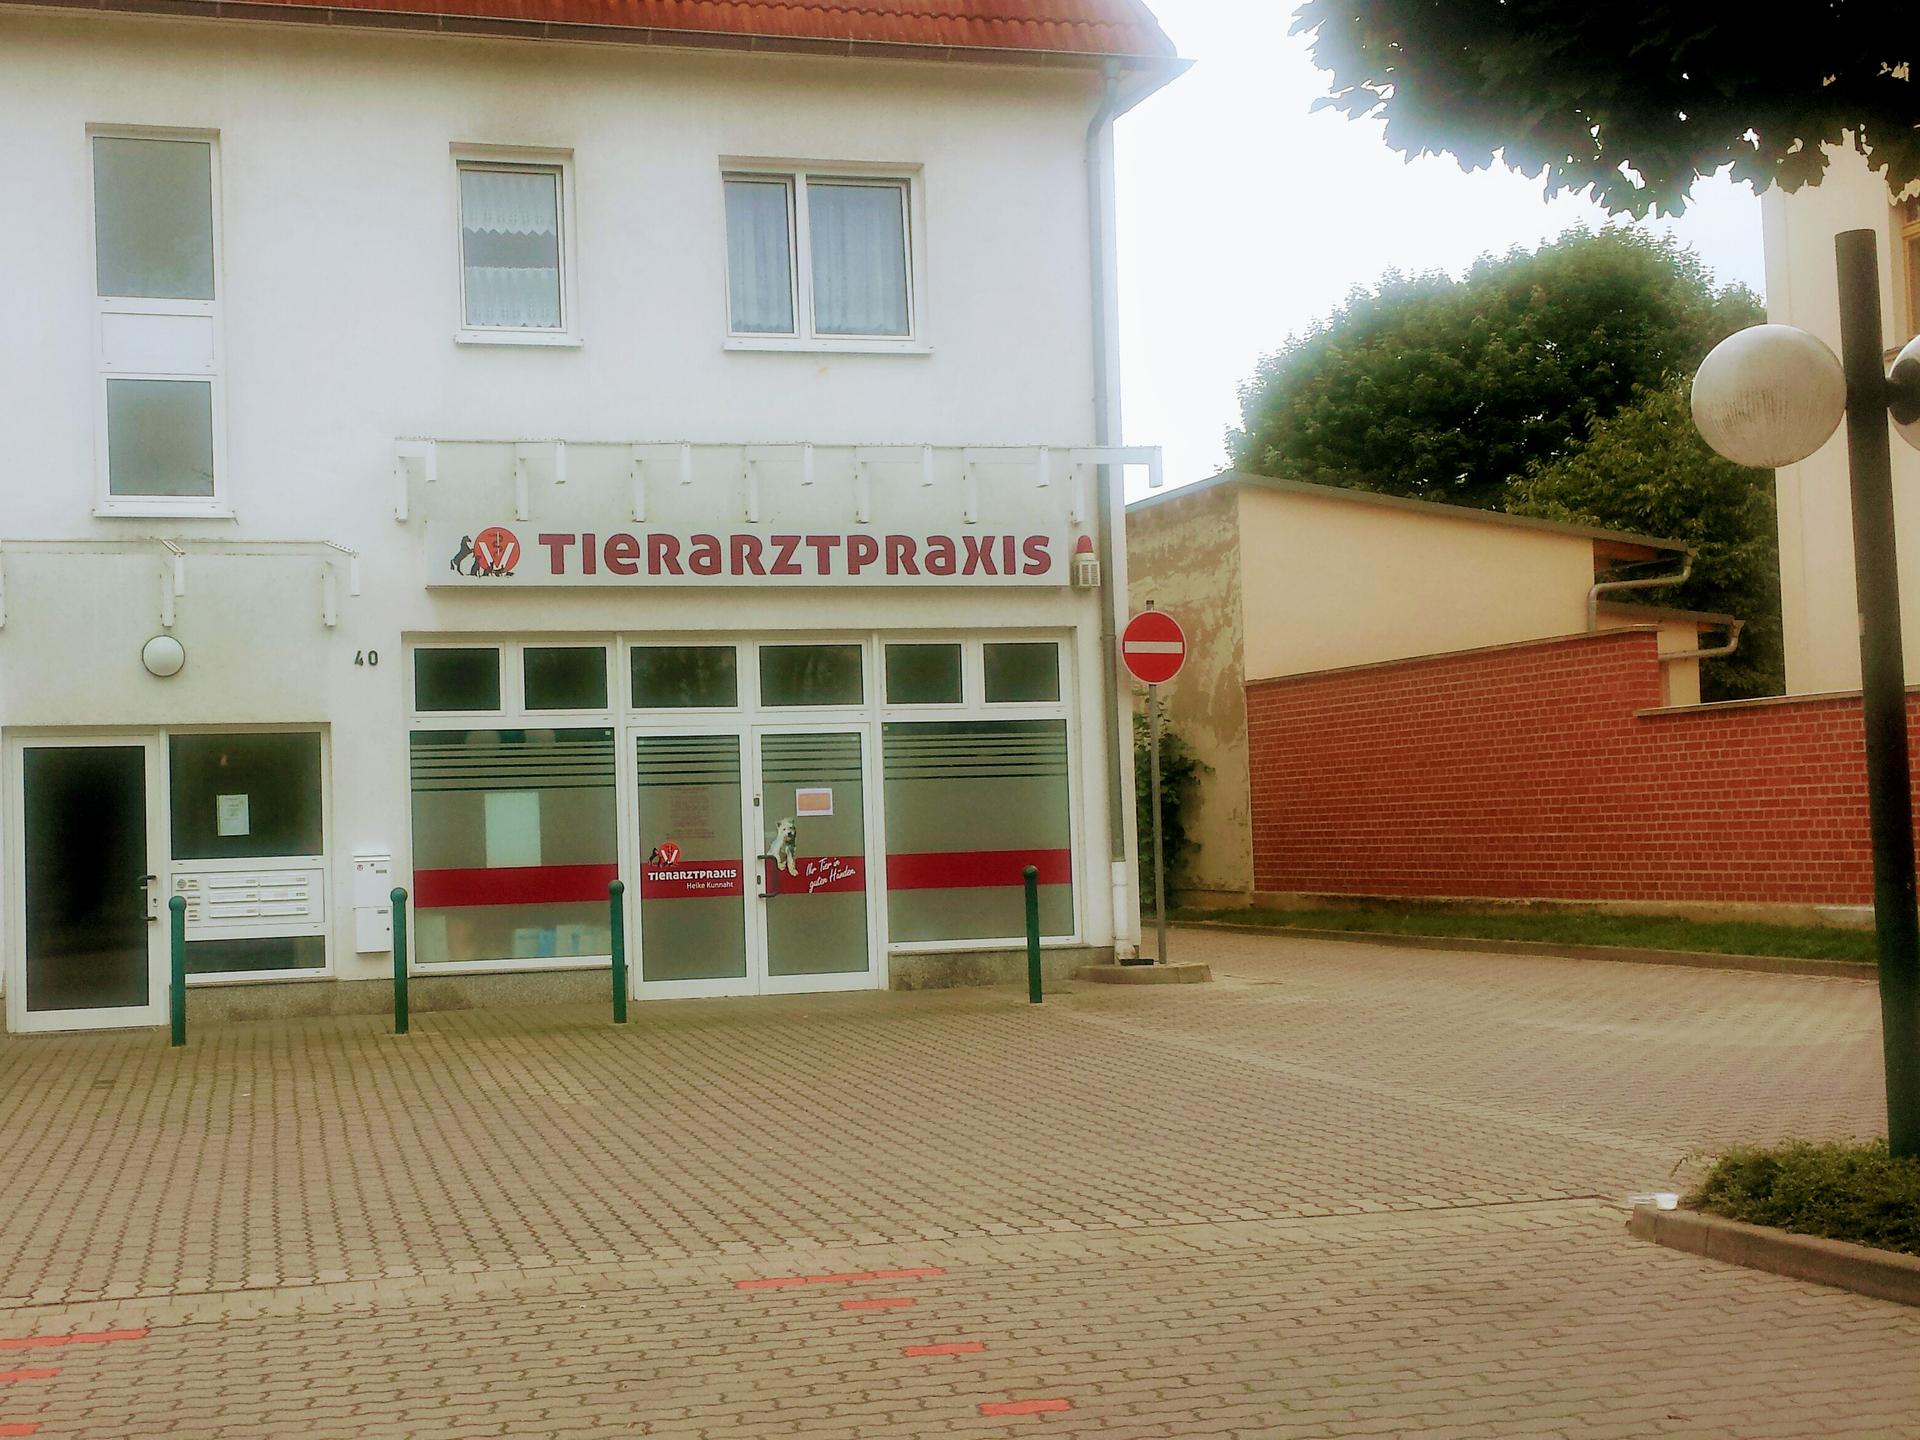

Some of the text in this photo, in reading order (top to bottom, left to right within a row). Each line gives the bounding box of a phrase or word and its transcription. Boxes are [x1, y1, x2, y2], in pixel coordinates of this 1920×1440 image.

[354, 650, 378, 666] 40
[805, 857, 840, 877] Ihr Tier in
[809, 865, 856, 893] guten Händen
